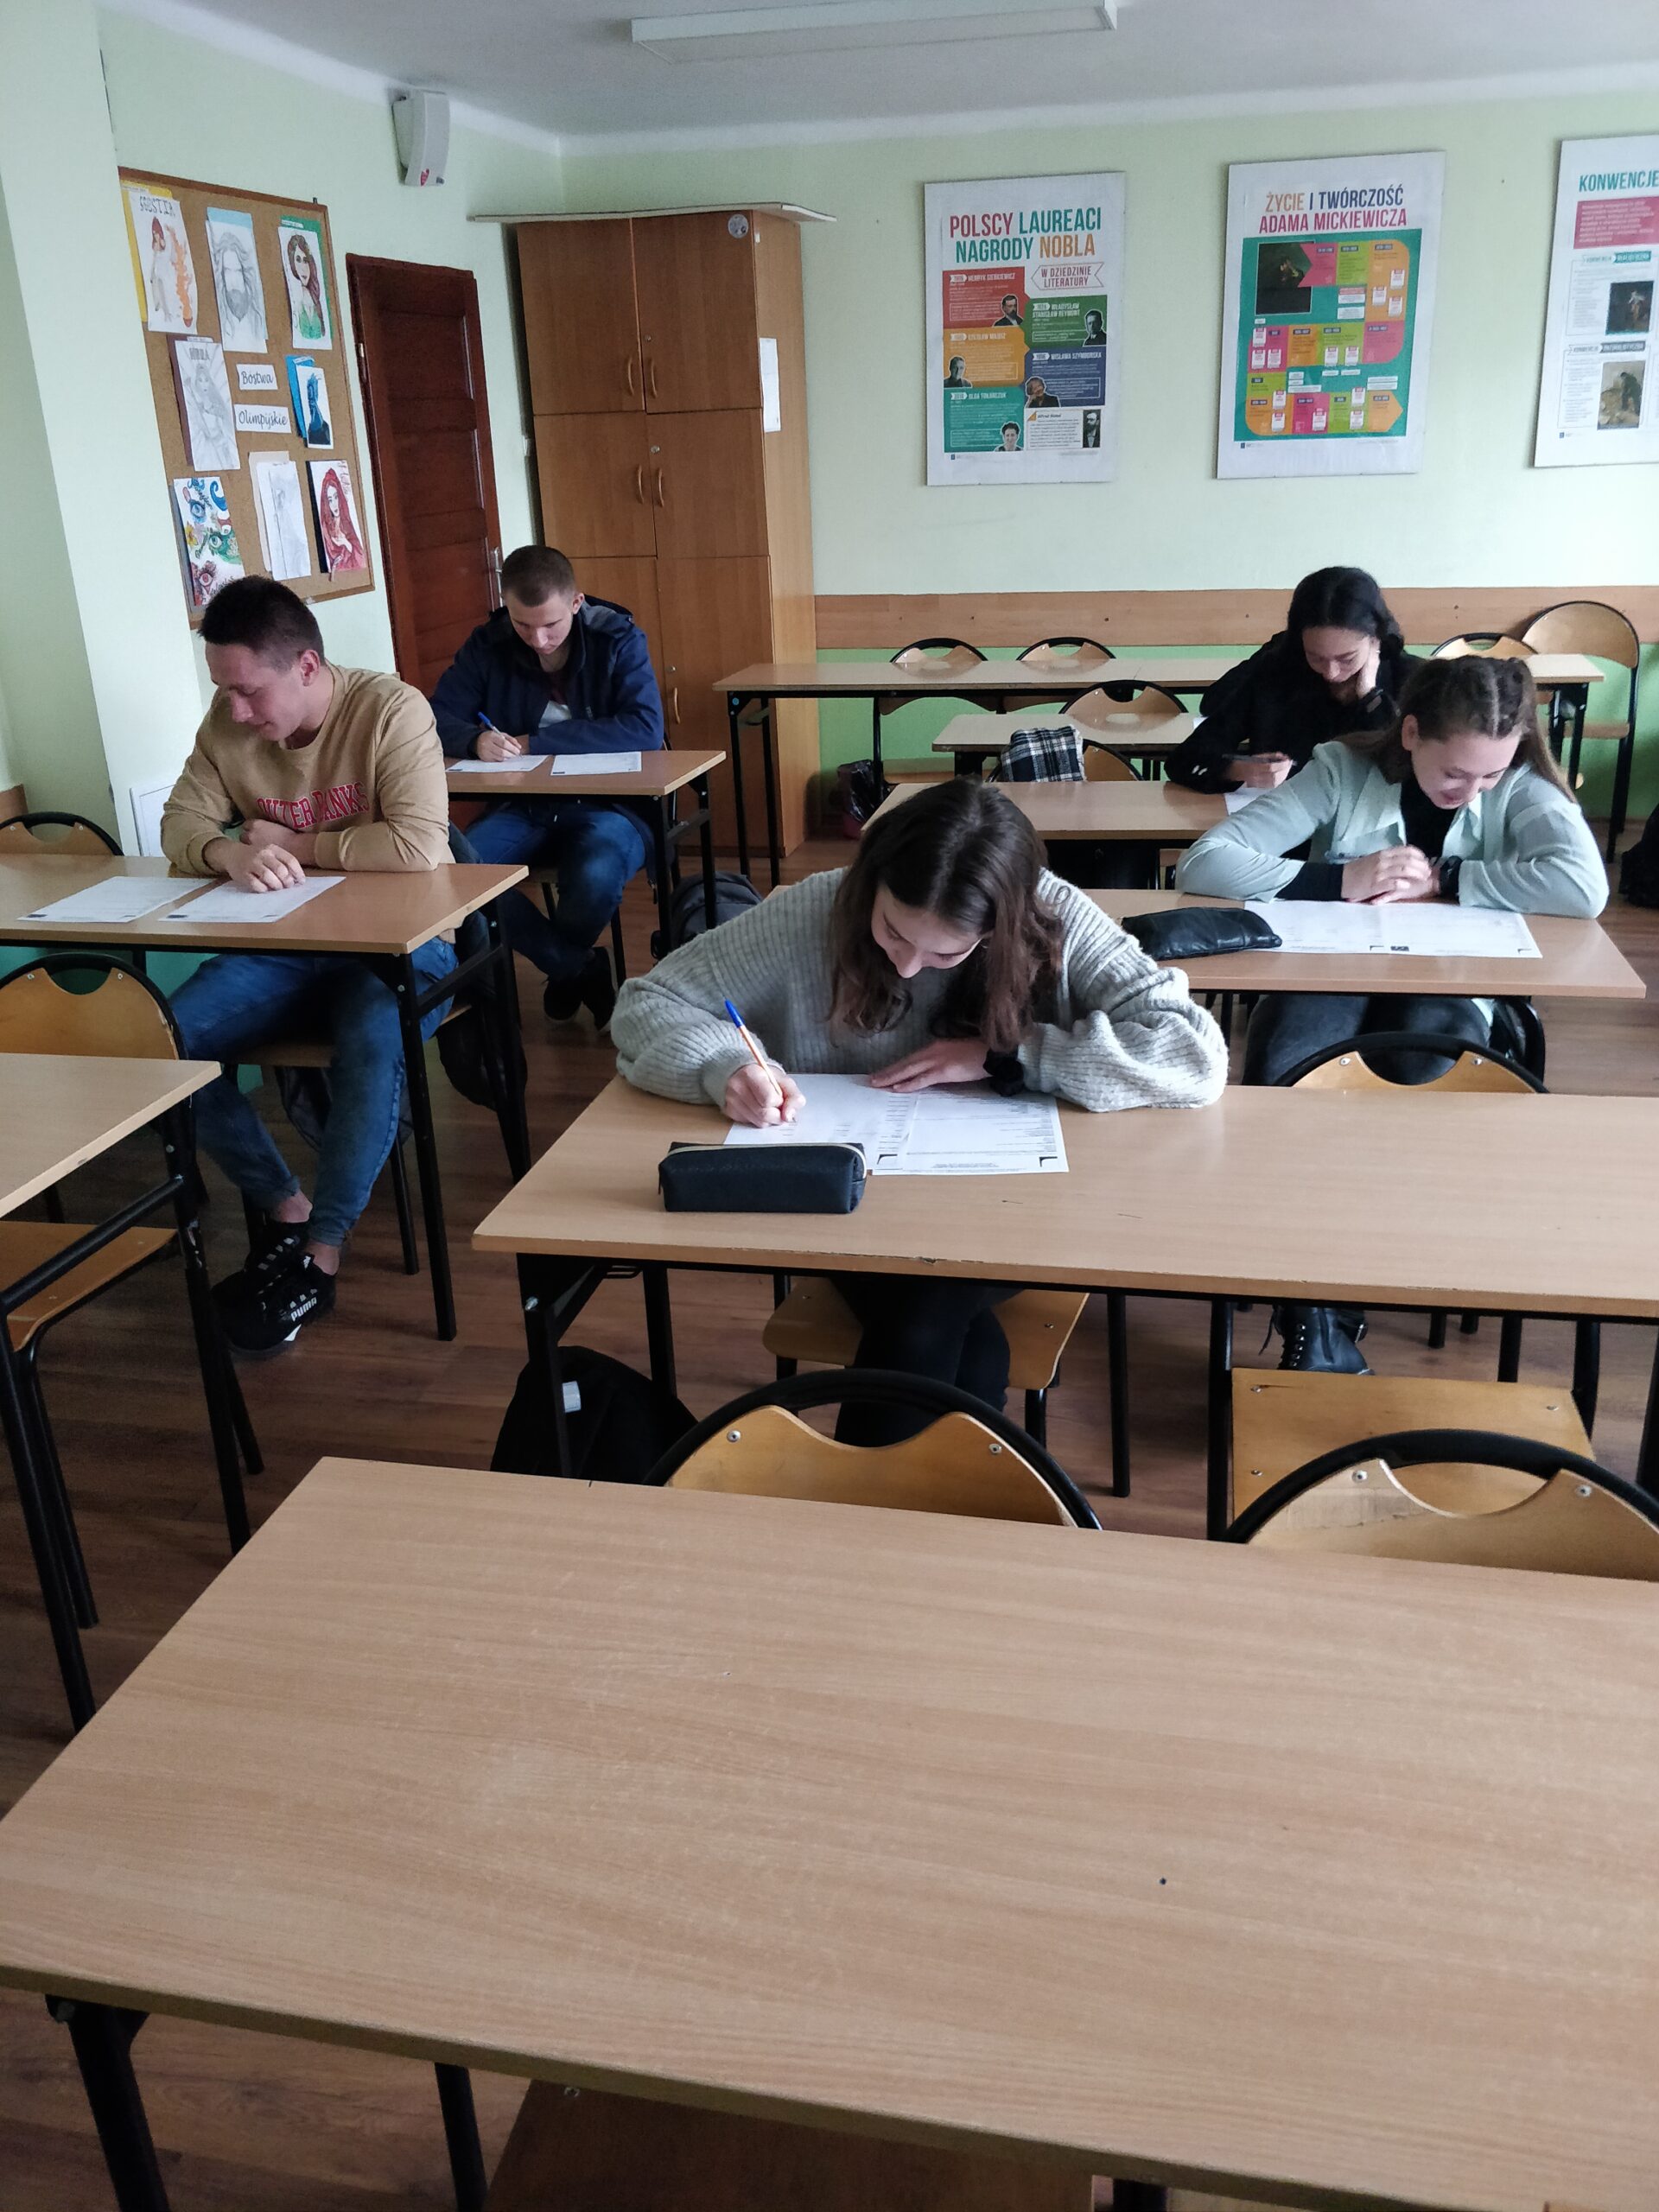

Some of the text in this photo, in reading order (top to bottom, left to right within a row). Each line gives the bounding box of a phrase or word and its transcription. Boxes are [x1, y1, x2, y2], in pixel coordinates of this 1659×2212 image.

[1266, 183, 1404, 213] ŻYCIE I TWÓRCZOŚĆ
[950, 207, 1102, 238] POLSCY LAUREACI
[1259, 207, 1408, 234] ADAMA MICKIEWICZA
[956, 233, 1096, 264] NAGRODY NOBLA
[1041, 265, 1091, 277] W DZIEDZINIE
[1044, 276, 1089, 288] LITERATURY
[241, 371, 274, 386] Bostwa
[238, 412, 289, 431] Olimpijskie
[290, 1297, 317, 1322] PUMA
